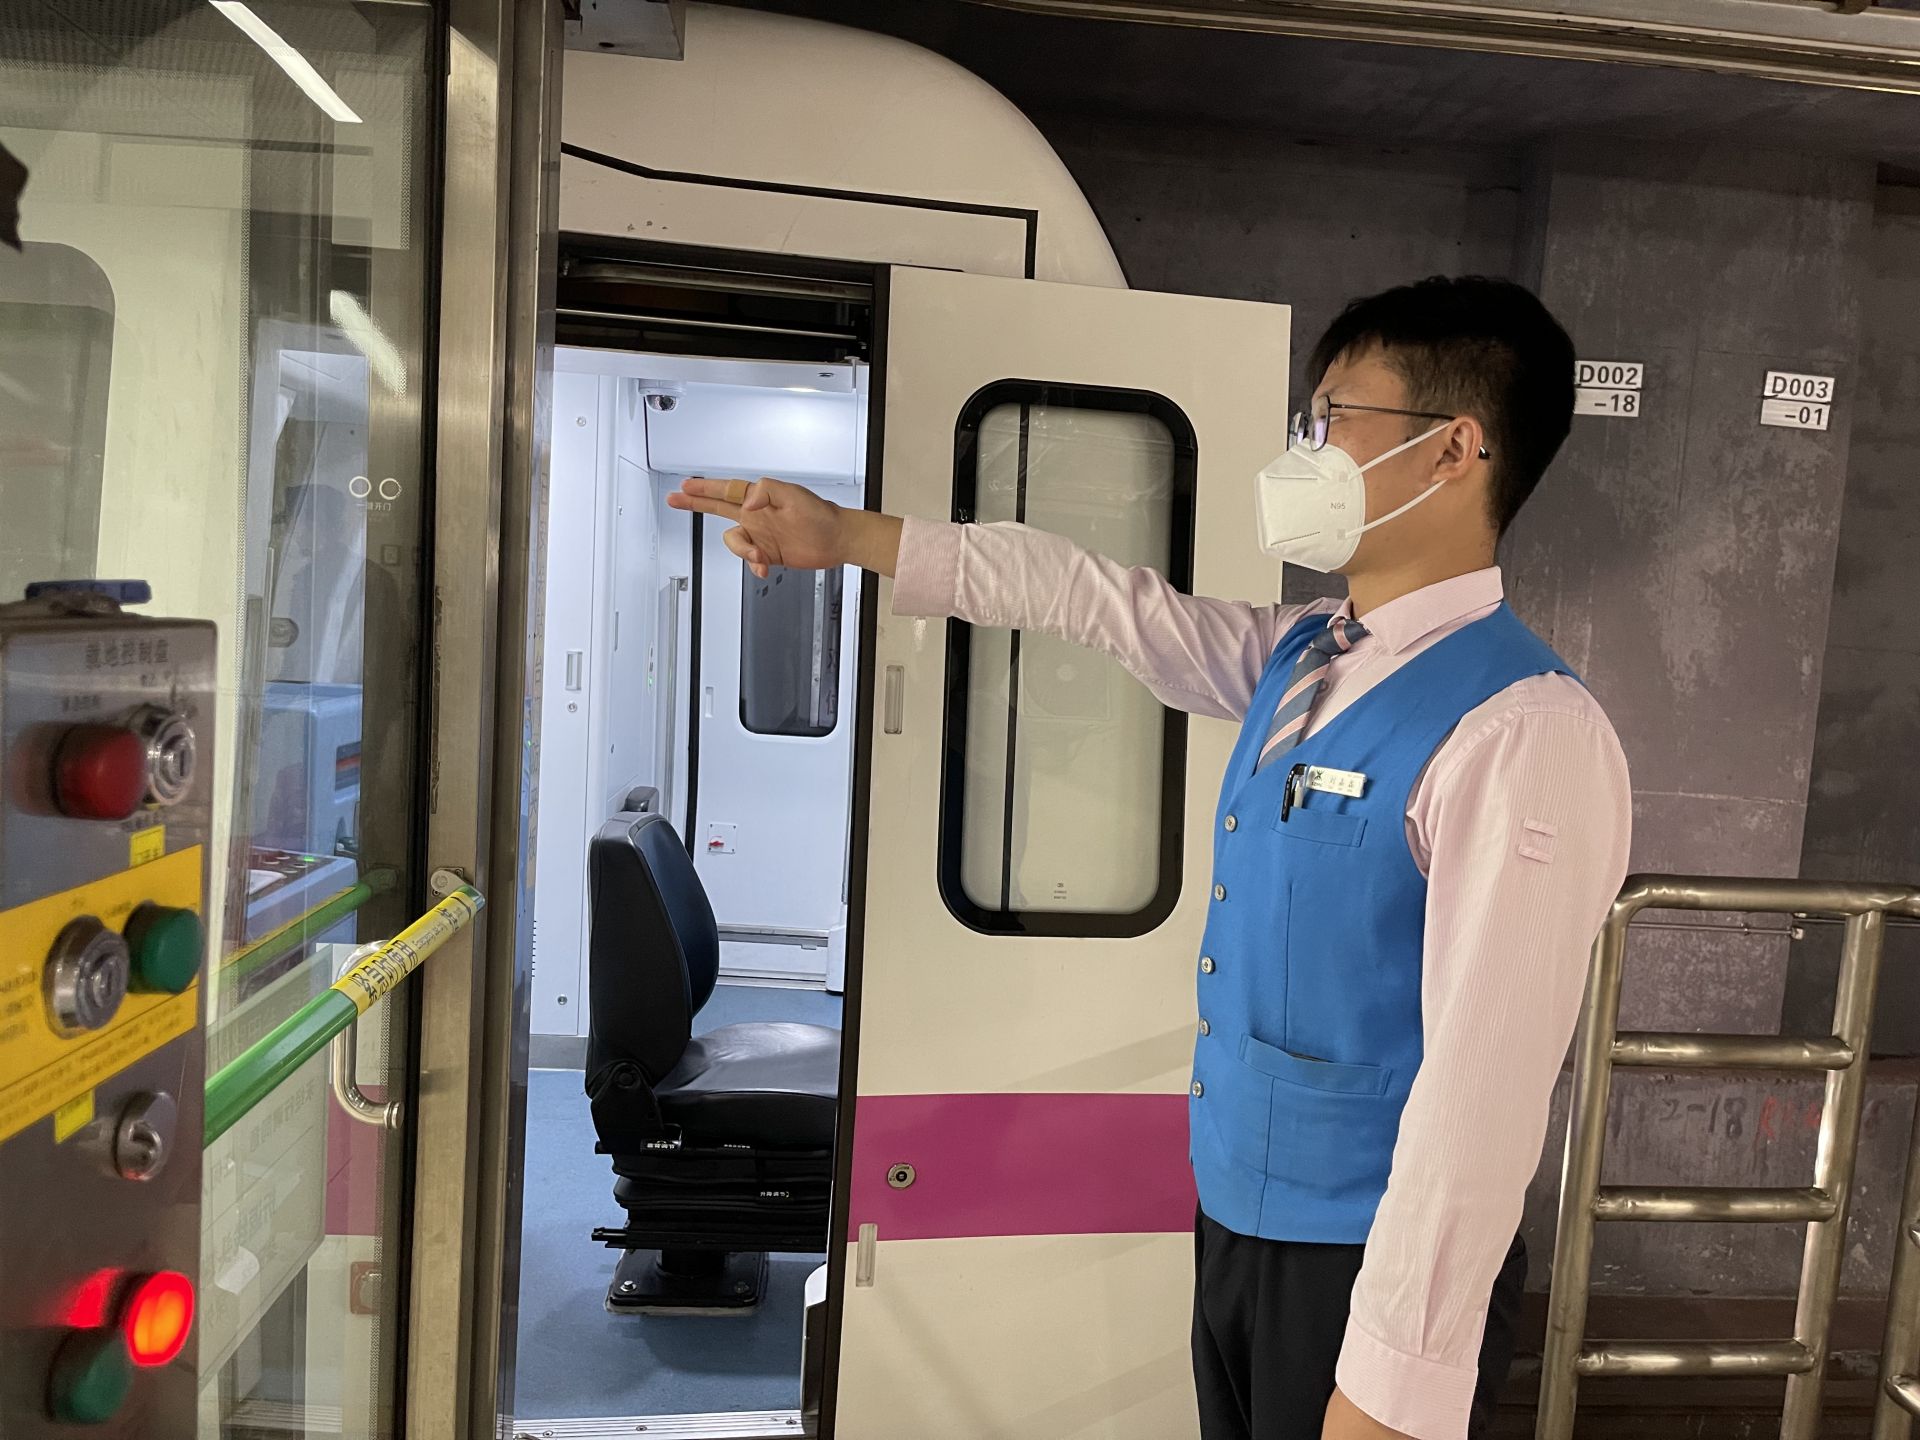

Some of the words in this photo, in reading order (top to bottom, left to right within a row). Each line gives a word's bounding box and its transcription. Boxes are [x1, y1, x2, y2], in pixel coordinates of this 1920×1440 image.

[1579, 364, 1639, 387] D002
[1771, 375, 1830, 399] D003
[1594, 393, 1636, 413] -18
[1784, 406, 1824, 426] -01
[1330, 502, 1346, 510] N95
